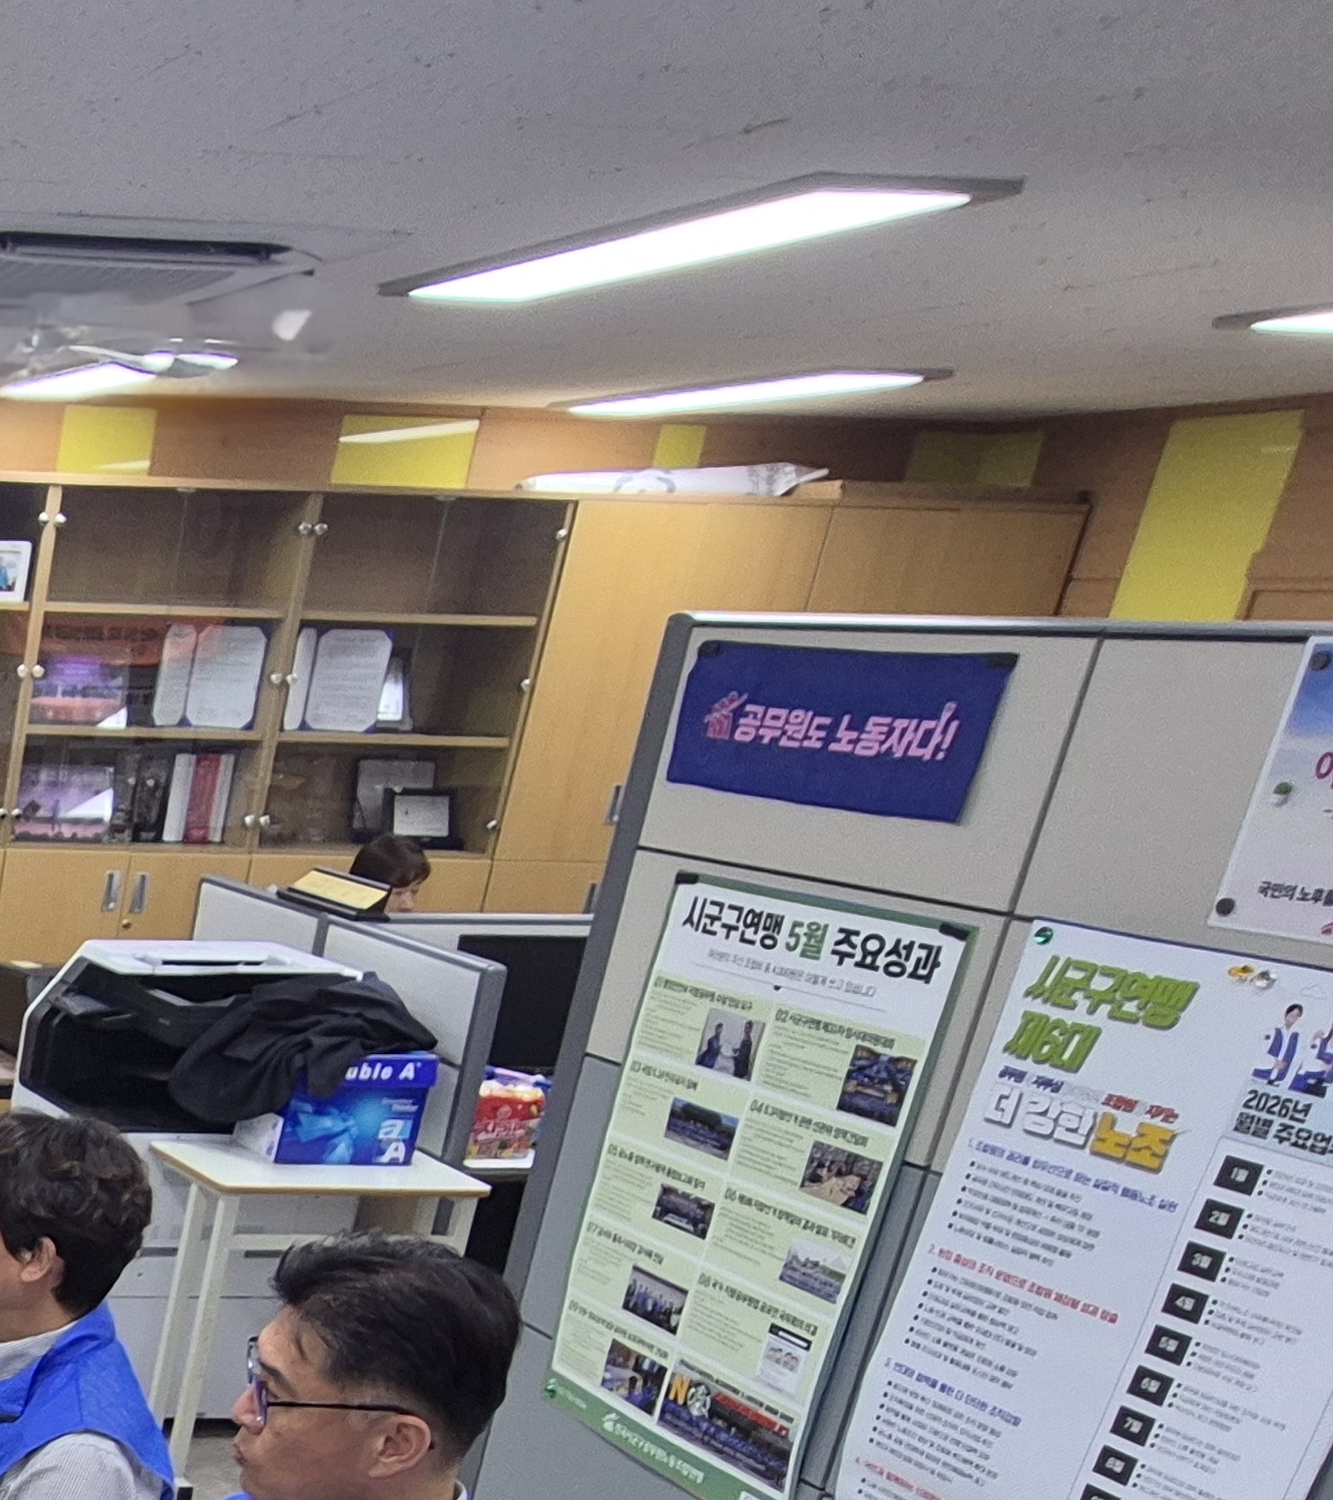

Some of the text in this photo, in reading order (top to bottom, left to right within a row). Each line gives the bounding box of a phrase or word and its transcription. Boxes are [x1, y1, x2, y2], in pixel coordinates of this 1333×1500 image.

[733, 701, 960, 761] 공무원도 노동자다!
[1258, 880, 1297, 900] 국민의
[682, 896, 942, 984] 시군구연맹 5월 주요성과
[1024, 955, 1201, 1030] 시군구연맹
[345, 1062, 415, 1081] uble A
[1002, 1010, 1103, 1074] 제6대
[983, 1084, 1183, 1174] 더 강한 노조
[1233, 1112, 1333, 1156] 월별 주요업
[1242, 1089, 1313, 1124] 2026년
